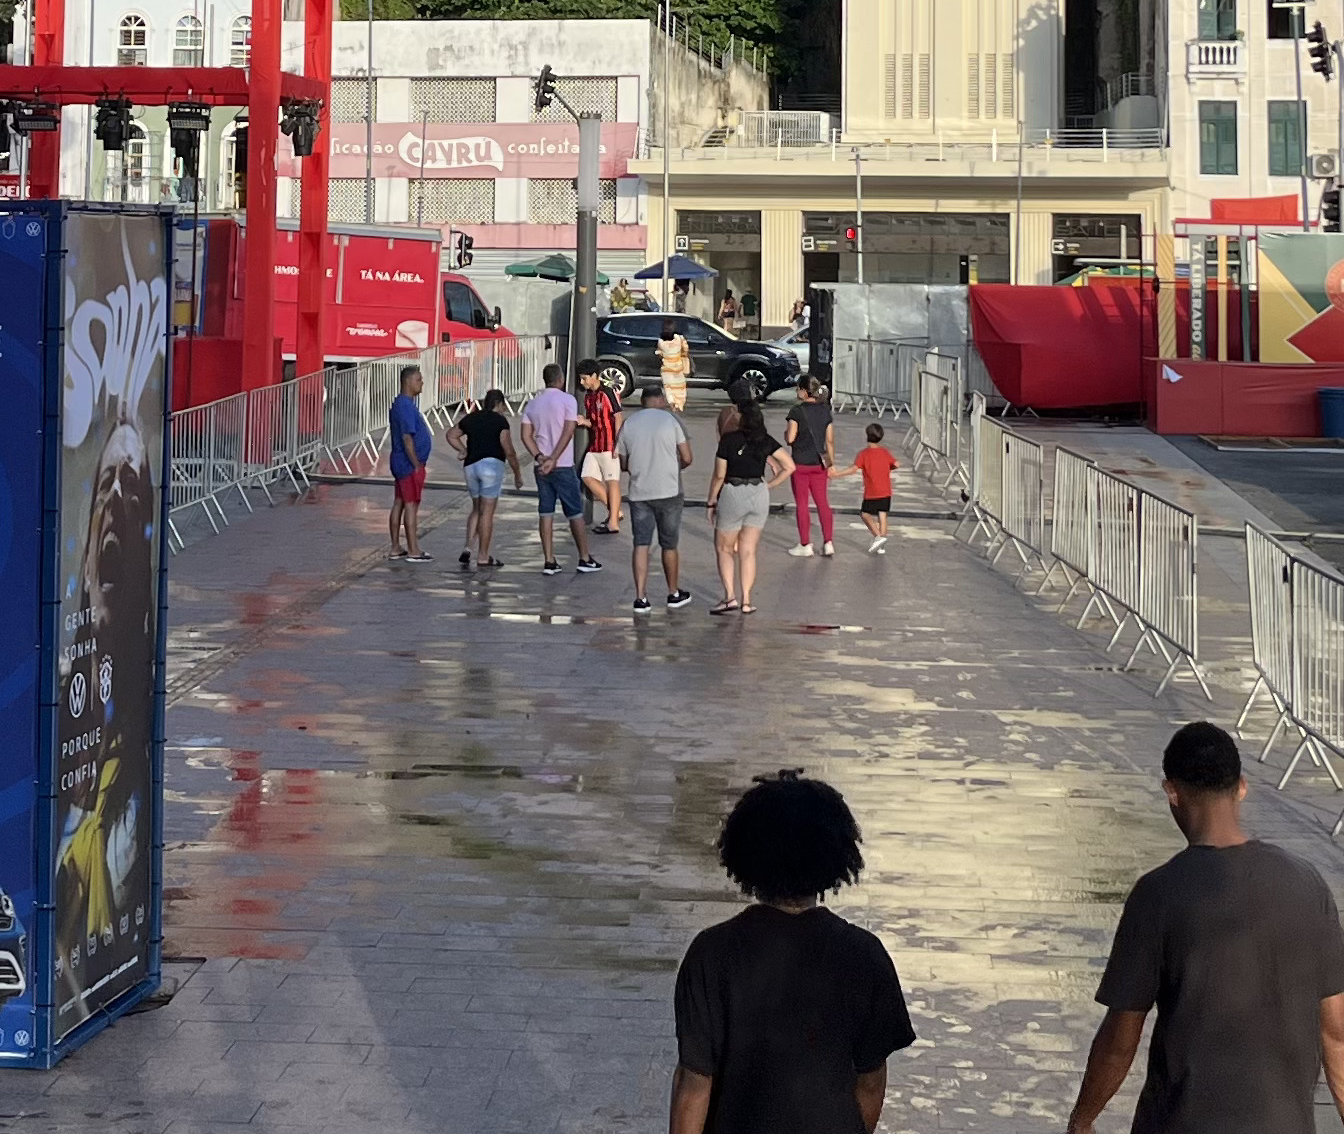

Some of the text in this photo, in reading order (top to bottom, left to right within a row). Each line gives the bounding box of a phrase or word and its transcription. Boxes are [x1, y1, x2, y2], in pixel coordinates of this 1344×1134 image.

[507, 137, 607, 156] confeitaa
[359, 268, 374, 281] TÁ
[375, 270, 391, 282] NA
[1191, 264, 1202, 342] LIBERADO
[64, 606, 97, 632] GENTE
[63, 637, 98, 662] SONHA
[61, 726, 101, 760] PORQUE
[60, 759, 98, 792] CONFIA
